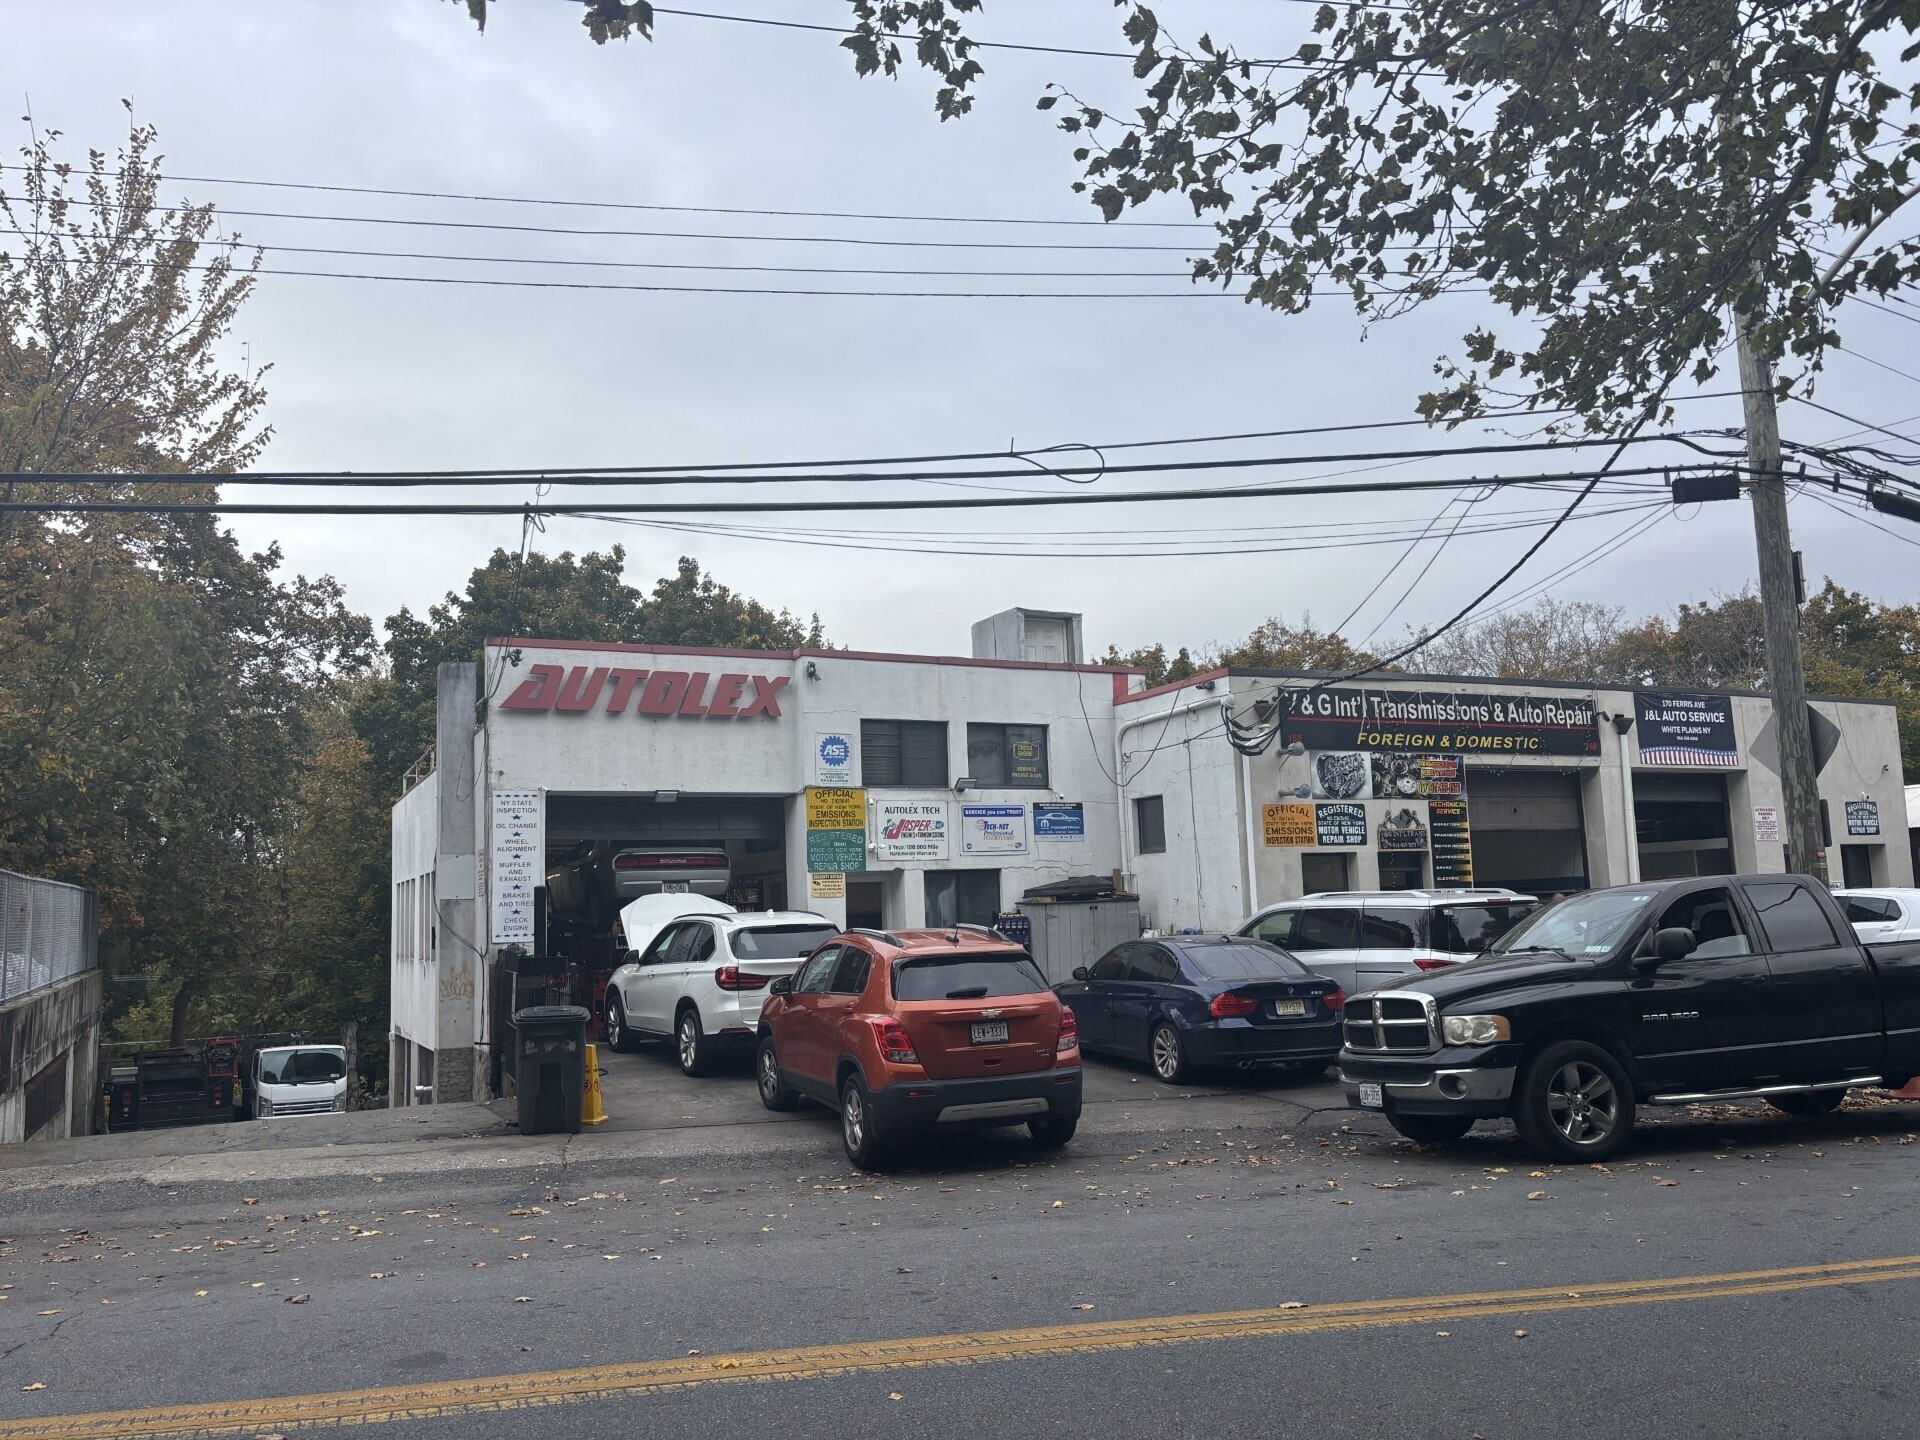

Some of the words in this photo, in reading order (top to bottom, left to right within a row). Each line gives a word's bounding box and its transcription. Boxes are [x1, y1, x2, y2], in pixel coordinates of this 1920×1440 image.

[498, 664, 791, 717] AUTOLEX
[1673, 700, 1693, 708] FERRIS
[1301, 694, 1314, 716] &
[1318, 694, 1332, 716] G
[1370, 697, 1488, 722] Transmissions
[1494, 702, 1504, 722] &
[1508, 703, 1542, 724] Auto
[1546, 704, 1592, 730] Repair
[1644, 710, 1661, 720] J&L
[1662, 711, 1687, 722] AUTO
[1688, 712, 1725, 723] SERVICE
[1357, 732, 1435, 746] FOREIGN
[1440, 735, 1450, 747] &
[1456, 735, 1539, 749] DOMESTIC
[824, 744, 845, 755] ASE
[815, 789, 856, 799] OFFICIAL
[1268, 804, 1309, 817] OFFICIAL
[1318, 804, 1364, 818] REGISTERED
[1848, 802, 1876, 813] REGISTERED
[816, 810, 856, 818] EMISSIONS
[809, 819, 840, 827] INSPECTION
[843, 819, 863, 827] STATION
[984, 821, 1009, 830] TECH-NET
[886, 819, 932, 839] JASPER
[1266, 827, 1313, 835] EMISSIONS
[1319, 826, 1339, 834] MOTOR
[1342, 826, 1365, 834] VEHICLE
[809, 832, 864, 844] REGISTERED
[1295, 836, 1314, 844] STATION
[1322, 835, 1344, 844] REPAIR
[1346, 835, 1362, 843] SHOP
[810, 853, 834, 861] MOTOR
[836, 853, 863, 861] VEHICLE
[814, 862, 838, 870] REPAIR
[840, 862, 859, 870] SHOP
[542, 974, 566, 987] 164
